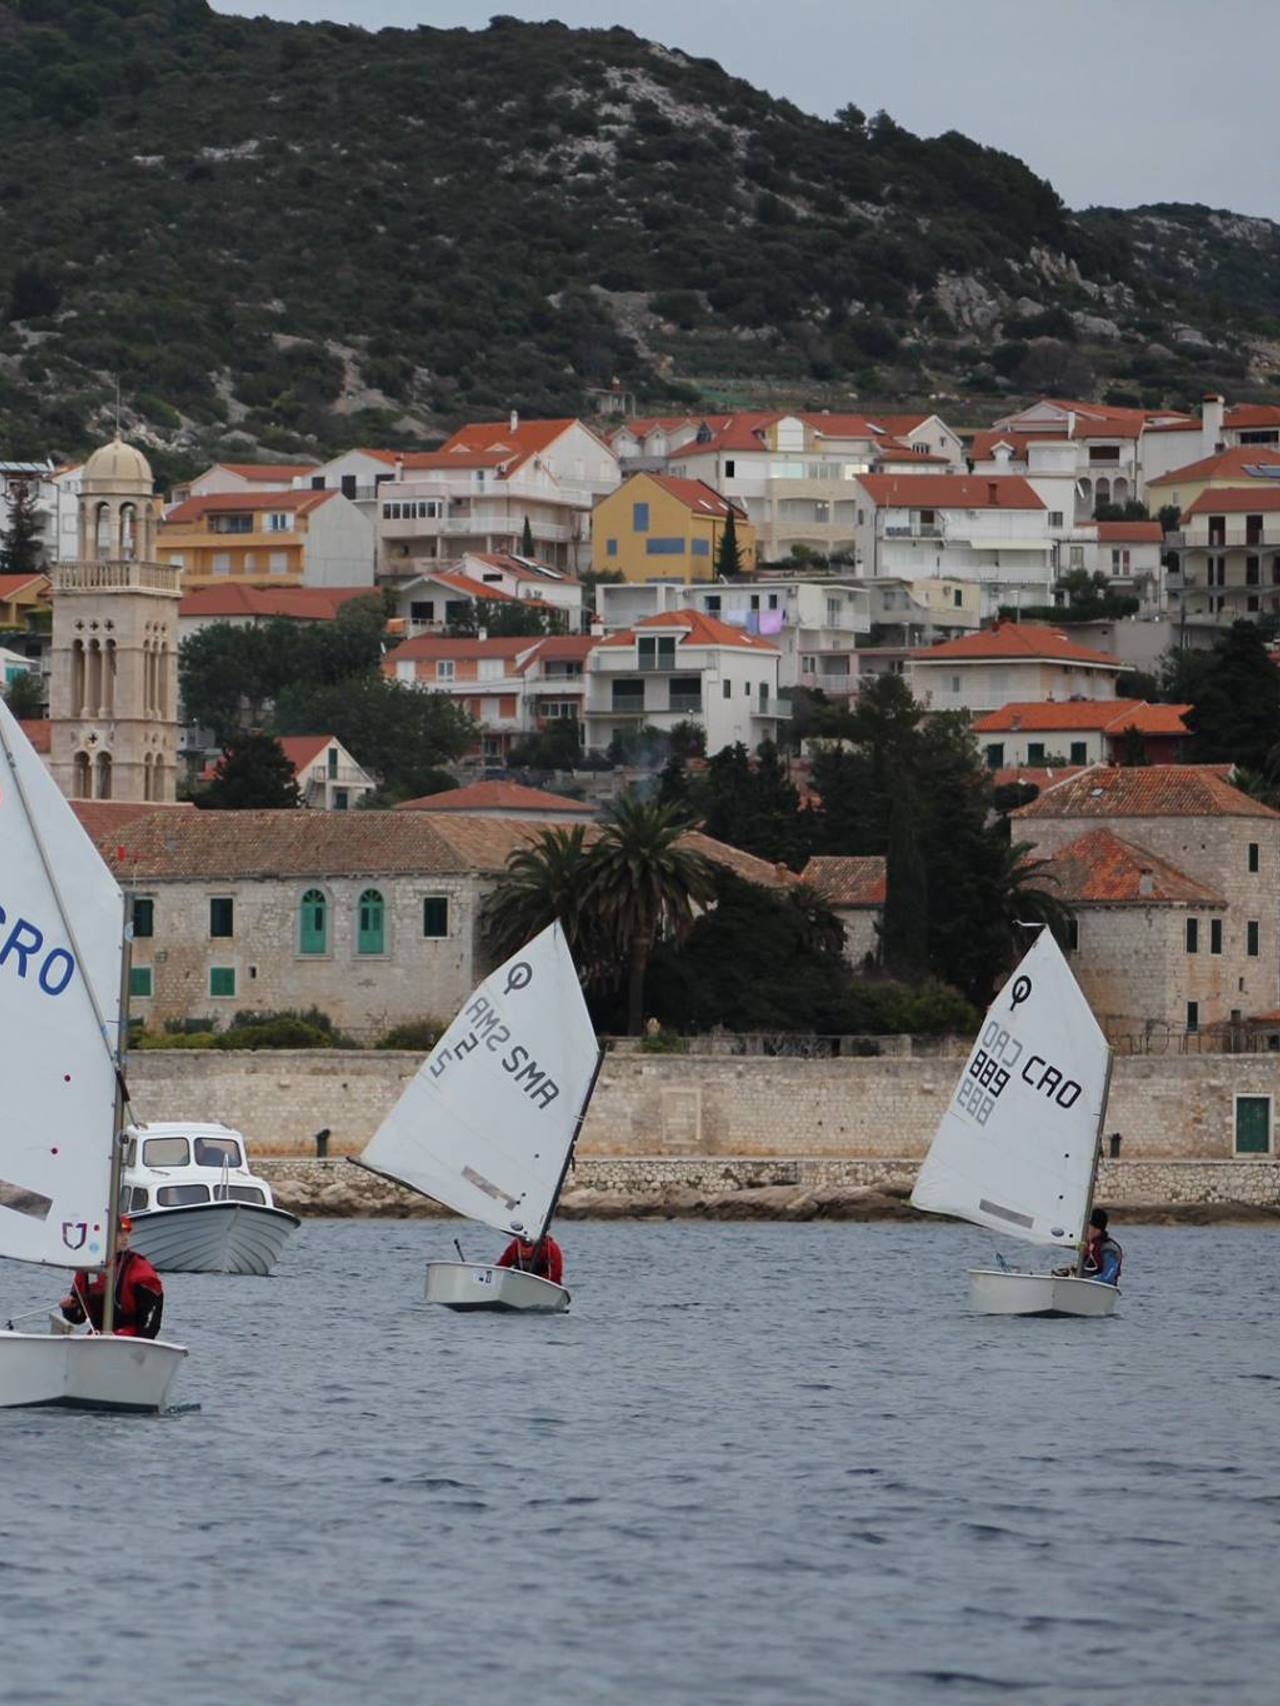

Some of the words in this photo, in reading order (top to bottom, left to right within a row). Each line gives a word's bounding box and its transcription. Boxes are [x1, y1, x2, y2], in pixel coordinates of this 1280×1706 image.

[502, 1046, 560, 1109] SMR
[969, 1049, 1011, 1098] 889
[1022, 1055, 1082, 1109] CRO
